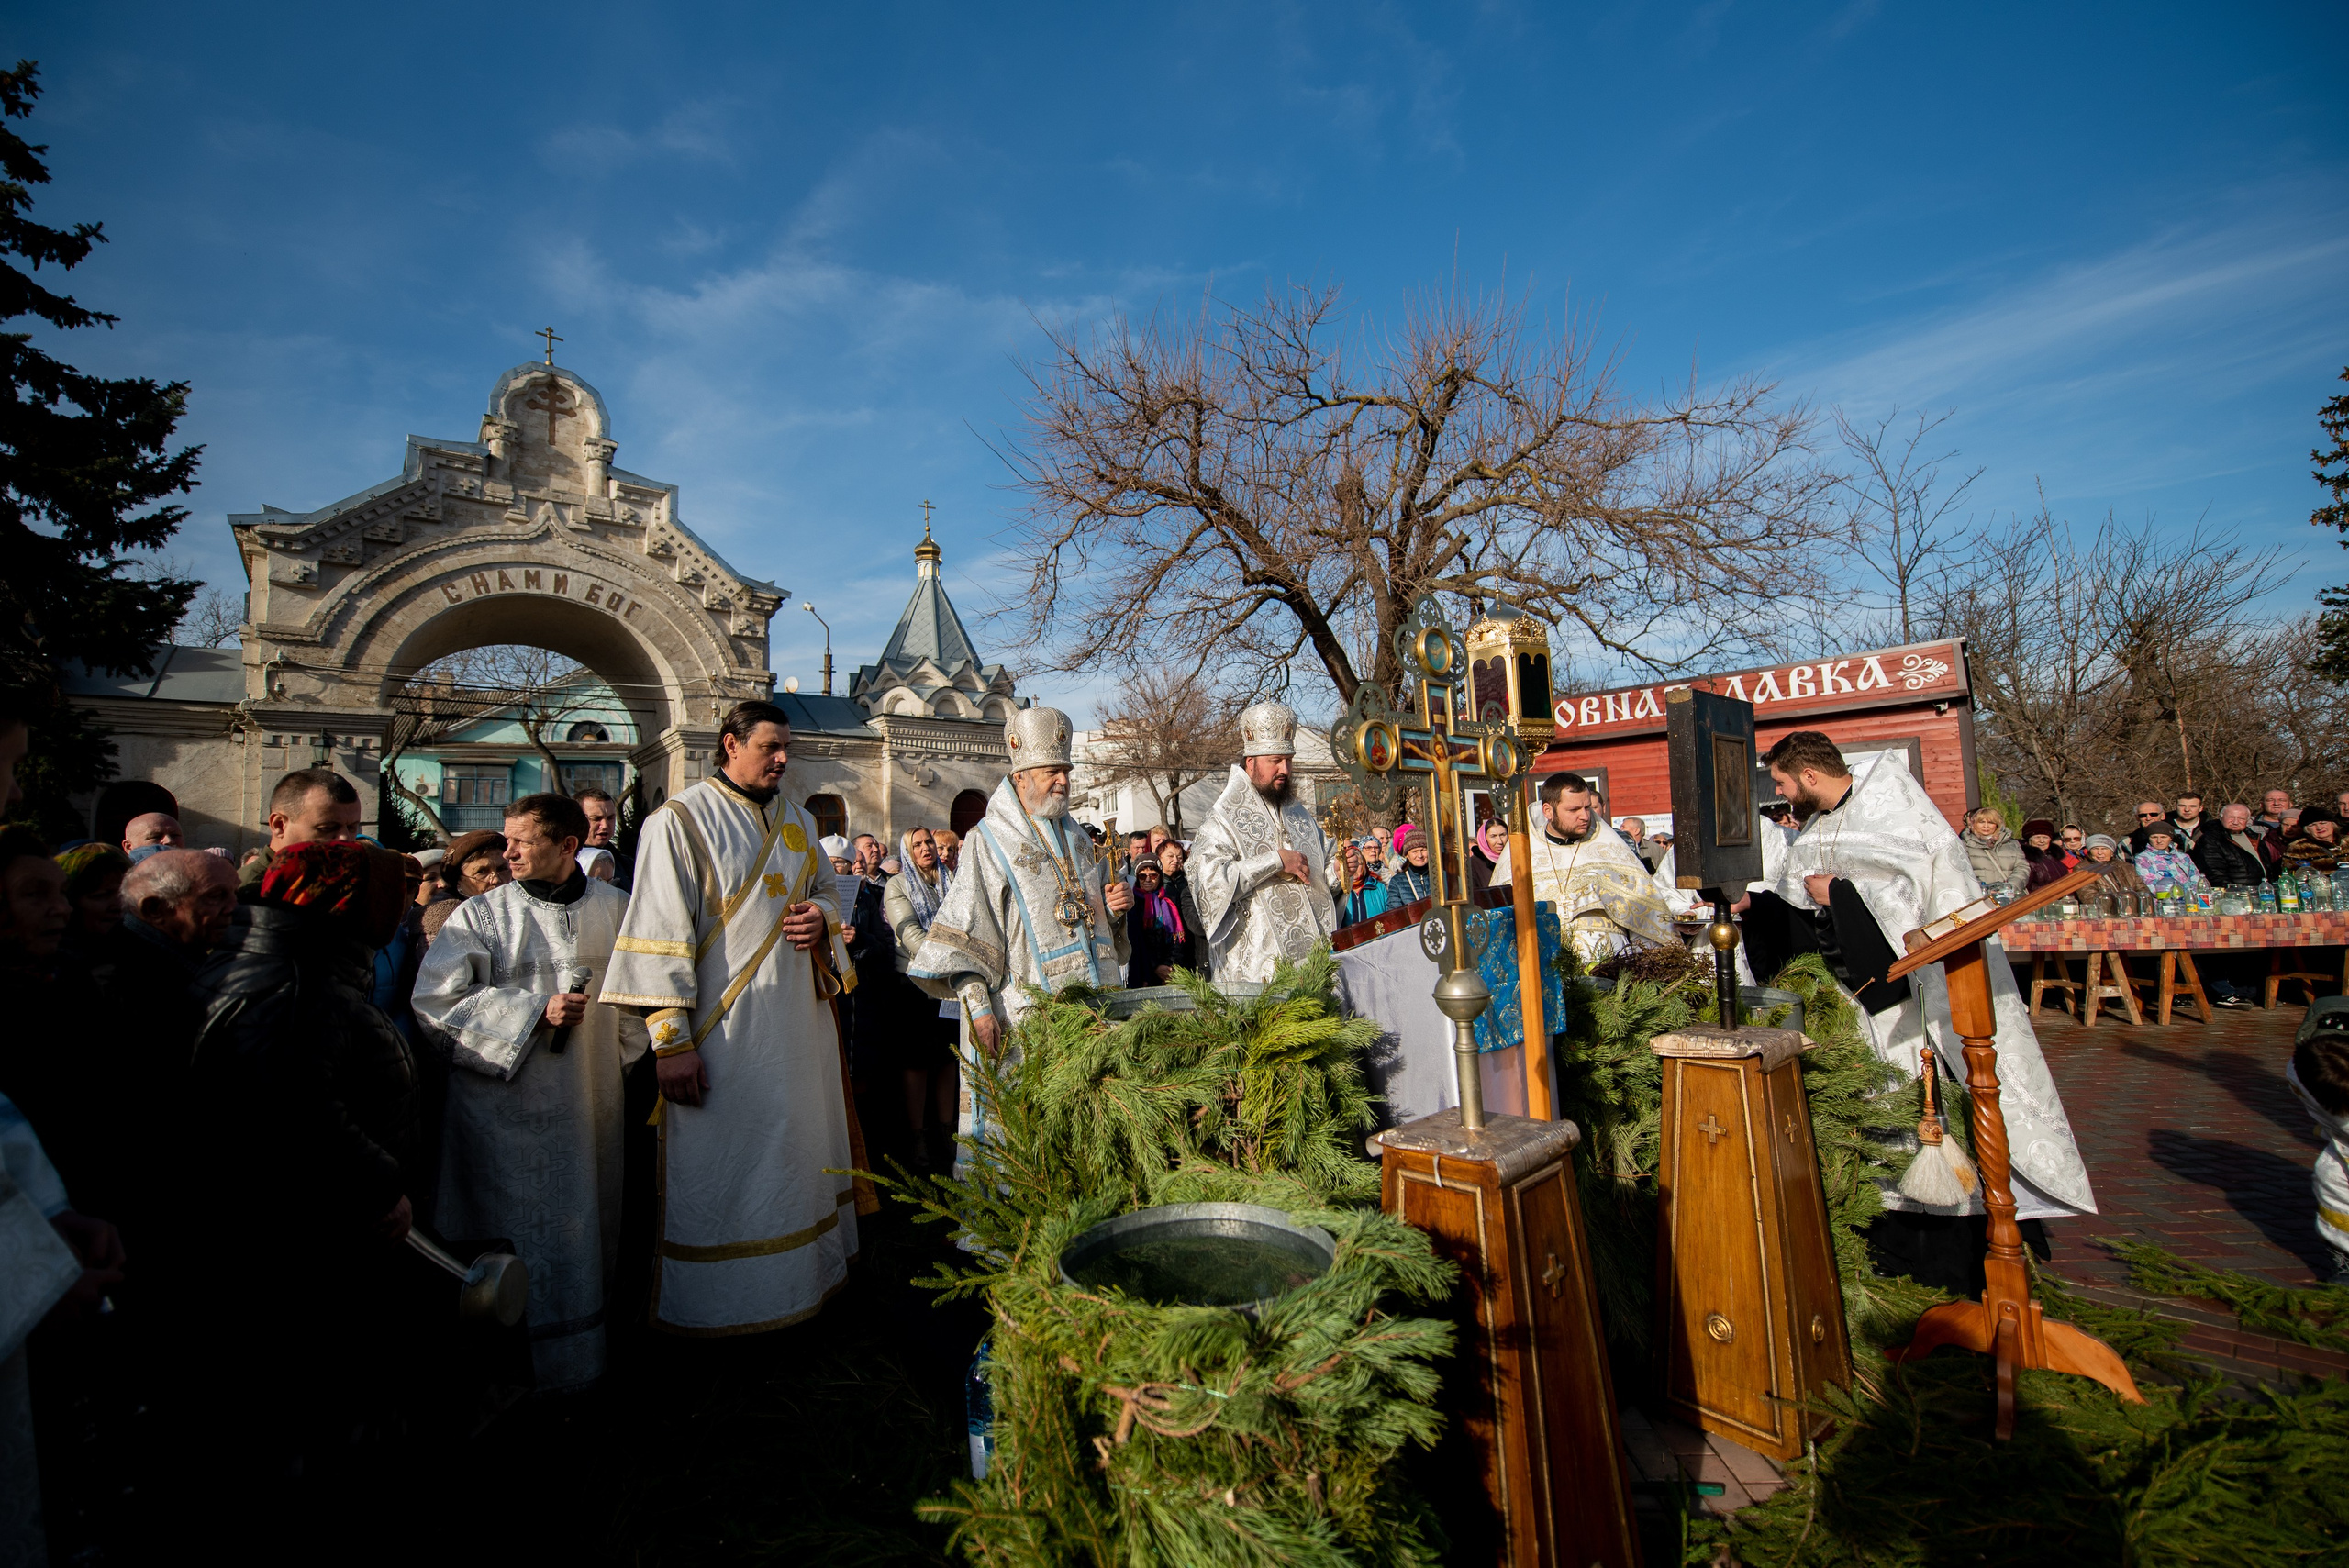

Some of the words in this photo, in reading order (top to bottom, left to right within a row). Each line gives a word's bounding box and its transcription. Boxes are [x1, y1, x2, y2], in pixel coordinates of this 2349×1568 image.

[469, 569, 568, 595] НАМИ
[584, 583, 642, 618] БОГ
[1725, 655, 1894, 705] ЛАВКА
